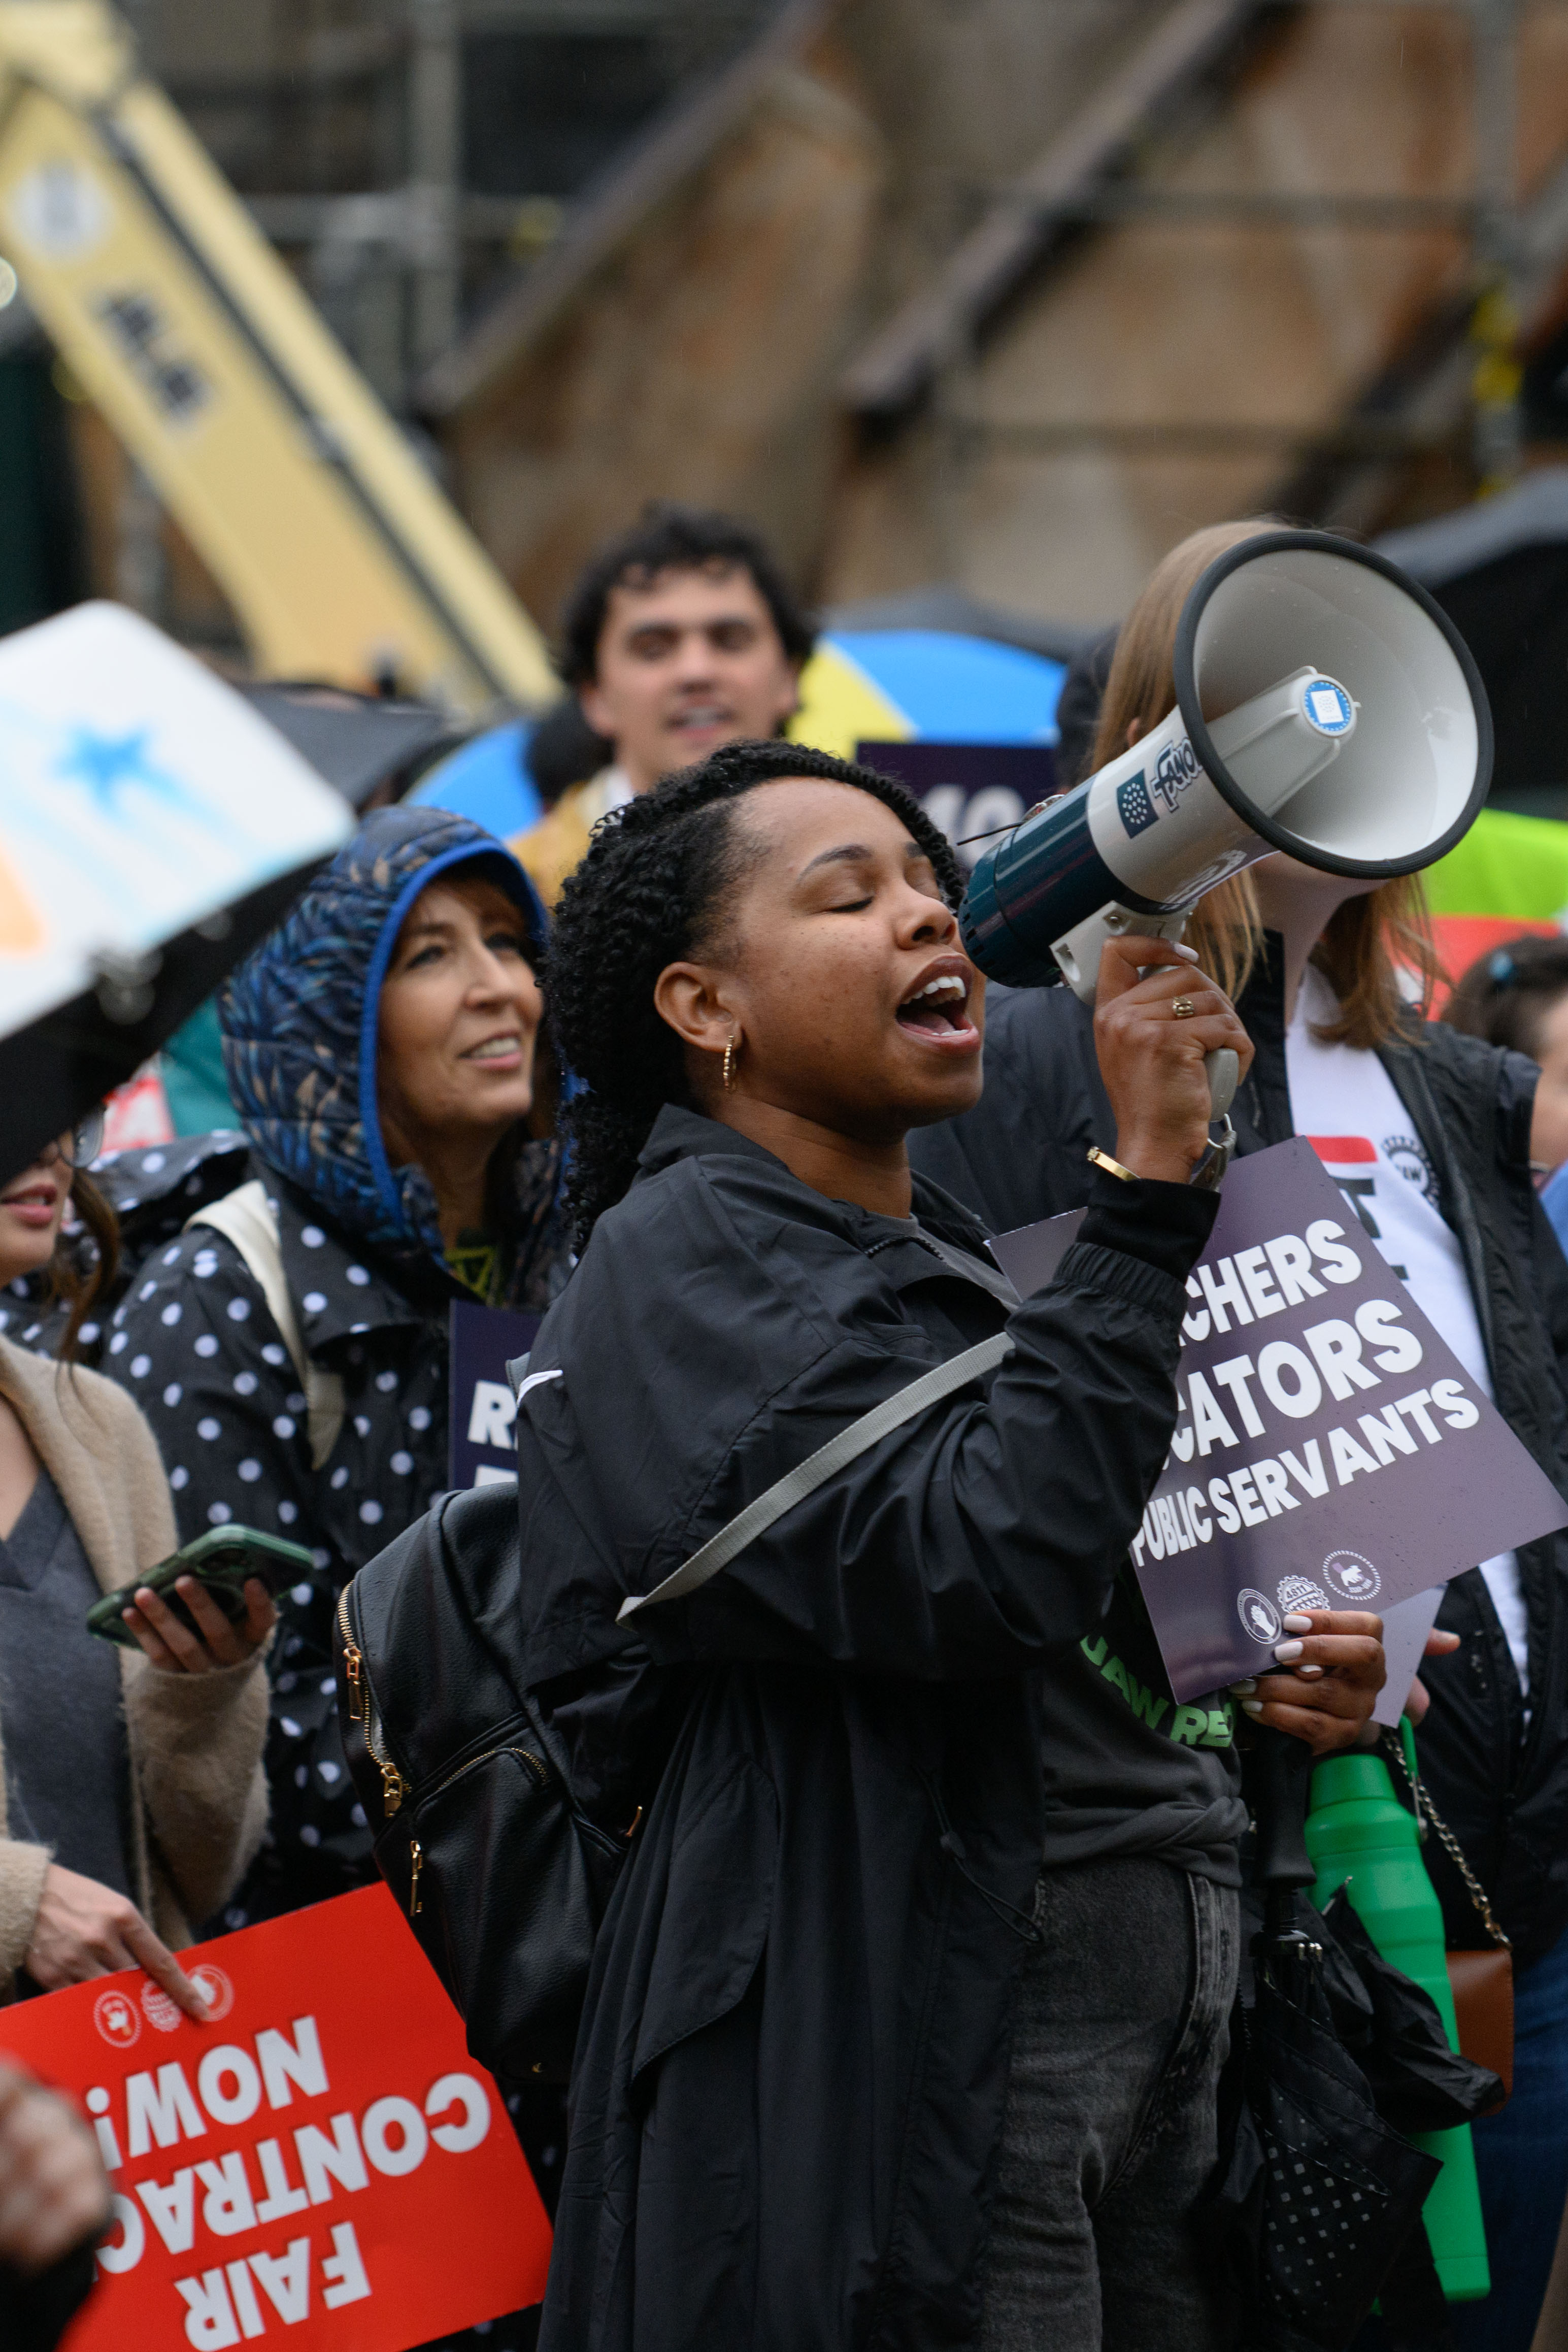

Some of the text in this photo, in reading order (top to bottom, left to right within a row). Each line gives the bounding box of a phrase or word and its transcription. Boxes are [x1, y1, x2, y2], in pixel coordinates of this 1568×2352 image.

[1150, 737, 1204, 813] FANO
[1179, 1219, 1362, 1347] CHERS
[467, 1379, 518, 1451] R
[1162, 1299, 1423, 1470] CATORS
[1132, 1379, 1479, 1567] PUBLIC SERVANTS
[86, 2015, 330, 2171] NOW!
[93, 2072, 491, 2282] CONTRAC
[173, 2221, 373, 2352] FAIR
